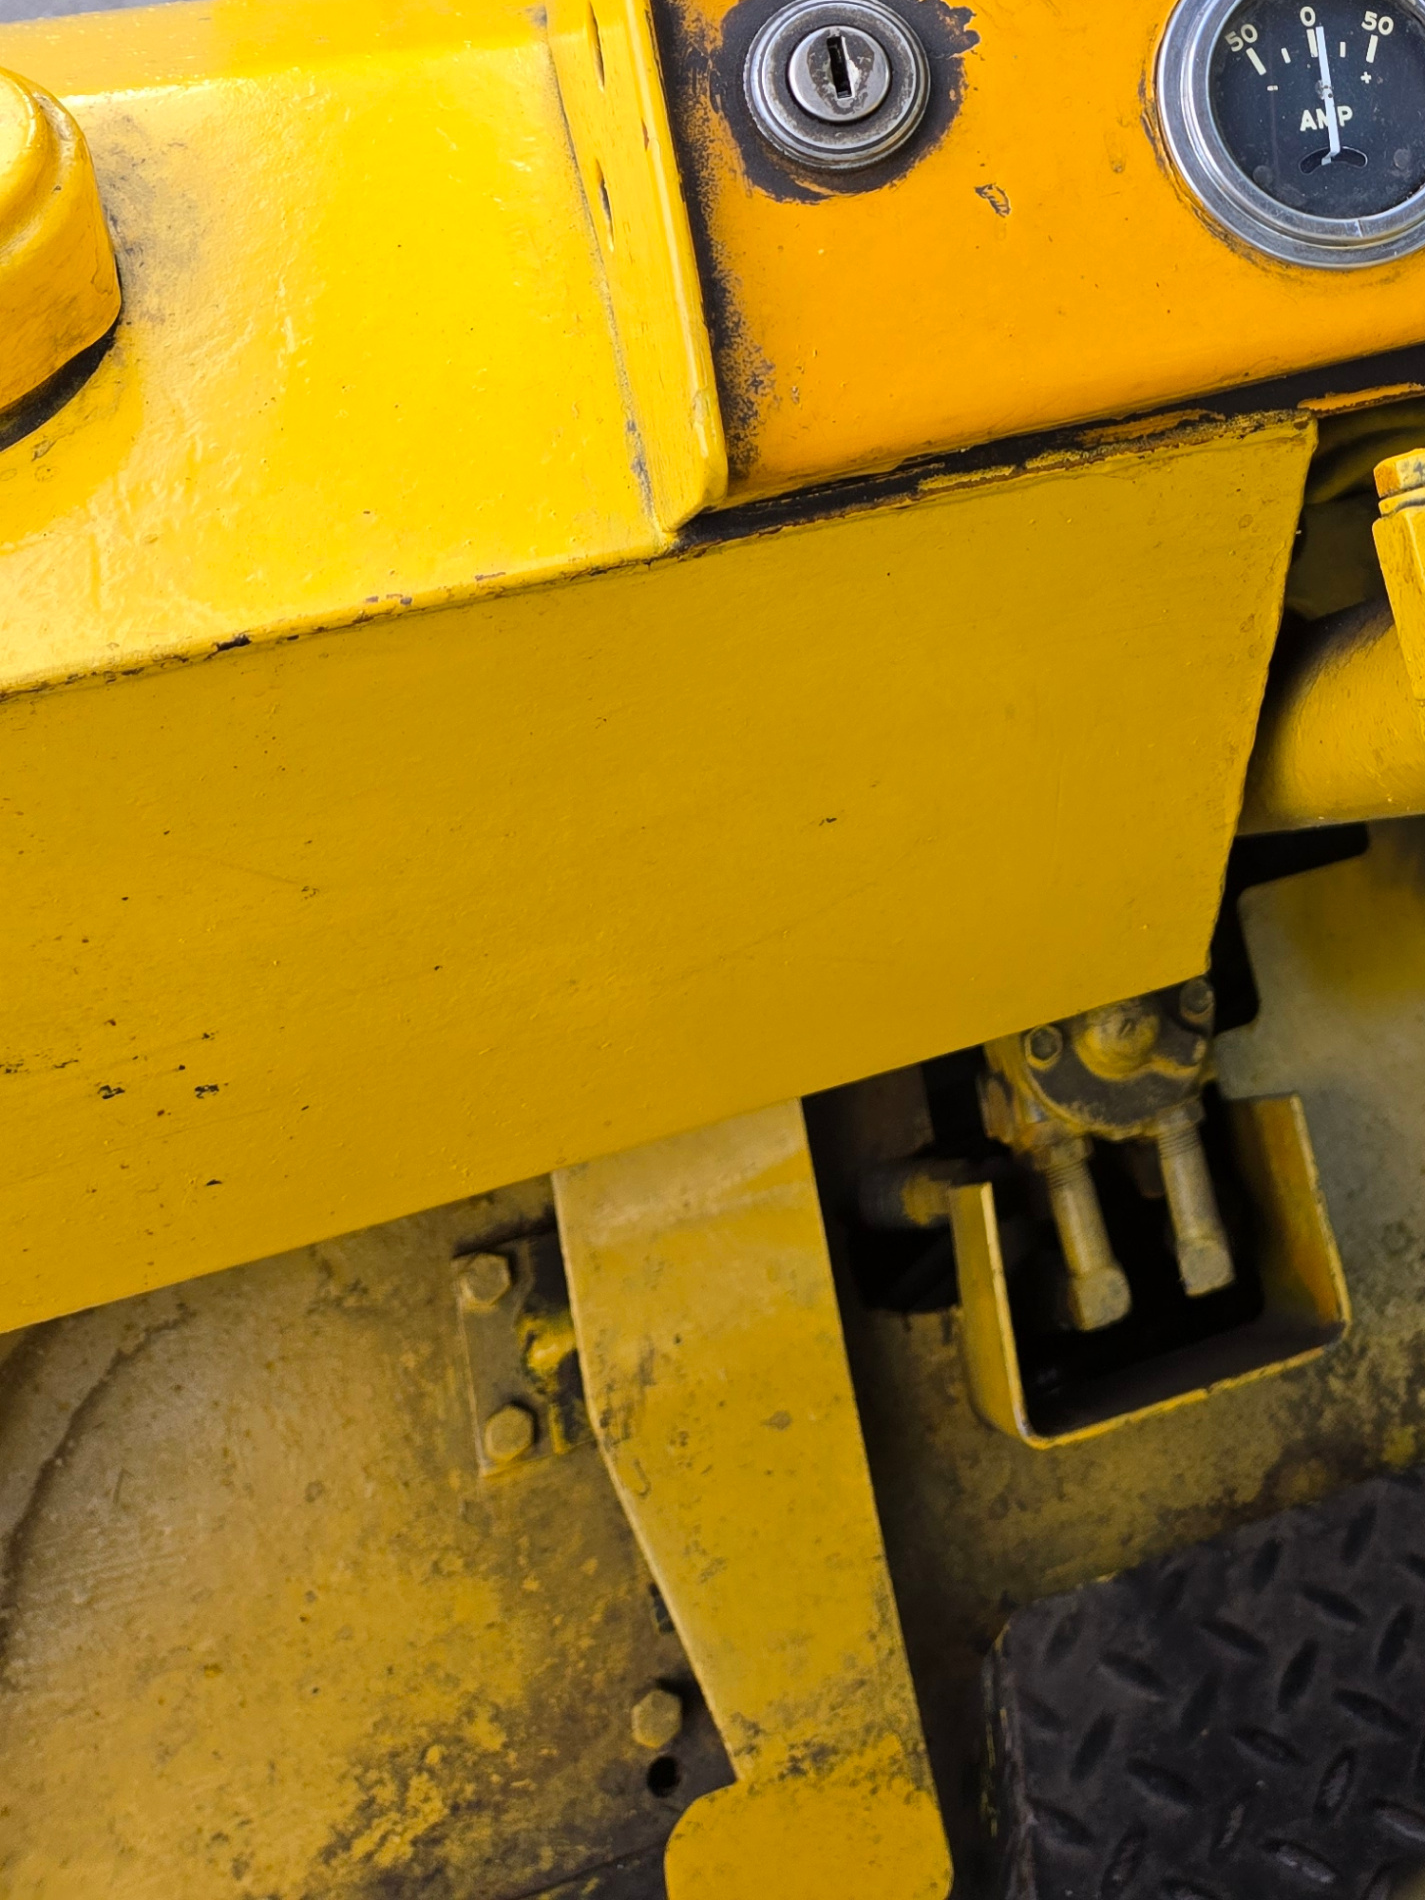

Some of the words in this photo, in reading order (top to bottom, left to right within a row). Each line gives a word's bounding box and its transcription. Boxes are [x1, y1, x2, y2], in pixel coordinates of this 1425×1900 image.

[1300, 6, 1316, 27] 0
[1361, 11, 1394, 36] 50
[1225, 24, 1258, 53] 50
